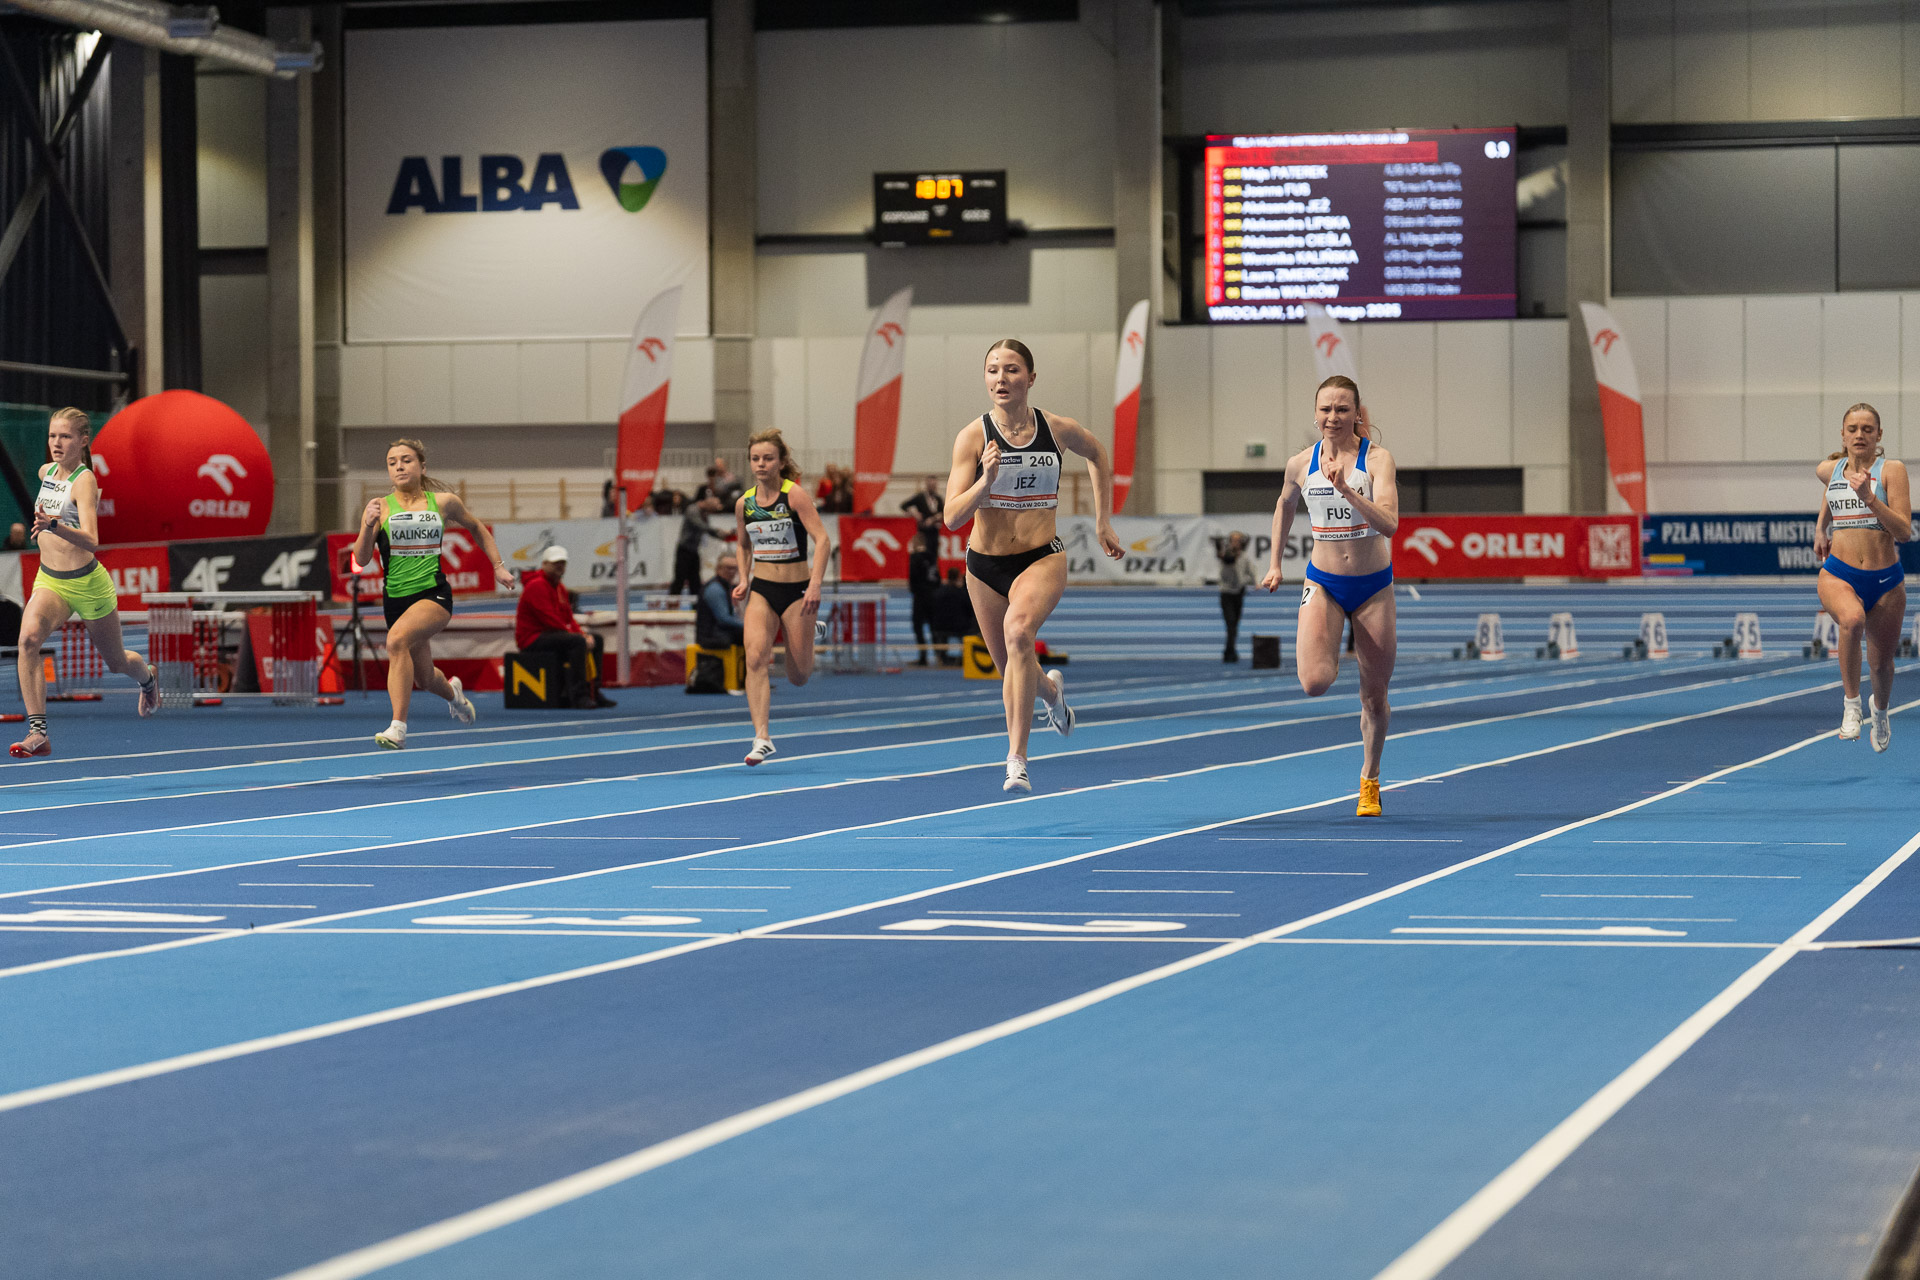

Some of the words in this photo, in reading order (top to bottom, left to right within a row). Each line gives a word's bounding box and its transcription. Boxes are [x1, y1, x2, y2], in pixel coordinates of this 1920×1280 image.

[386, 154, 580, 215] ALBA
[1029, 456, 1054, 467] 240
[1014, 474, 1037, 490] JEŻ
[188, 498, 251, 519] ORLEN
[419, 513, 438, 522] 284
[1327, 508, 1351, 520] FUS
[391, 527, 440, 540] KALIŃSKA
[769, 521, 791, 532] 1279
[1662, 522, 1701, 545] PZLA
[1703, 521, 1767, 544] HALOWE
[1461, 532, 1565, 559] ORLEN
[261, 548, 317, 590] 4F
[591, 561, 647, 579] DZA
[112, 566, 159, 595] LEN
